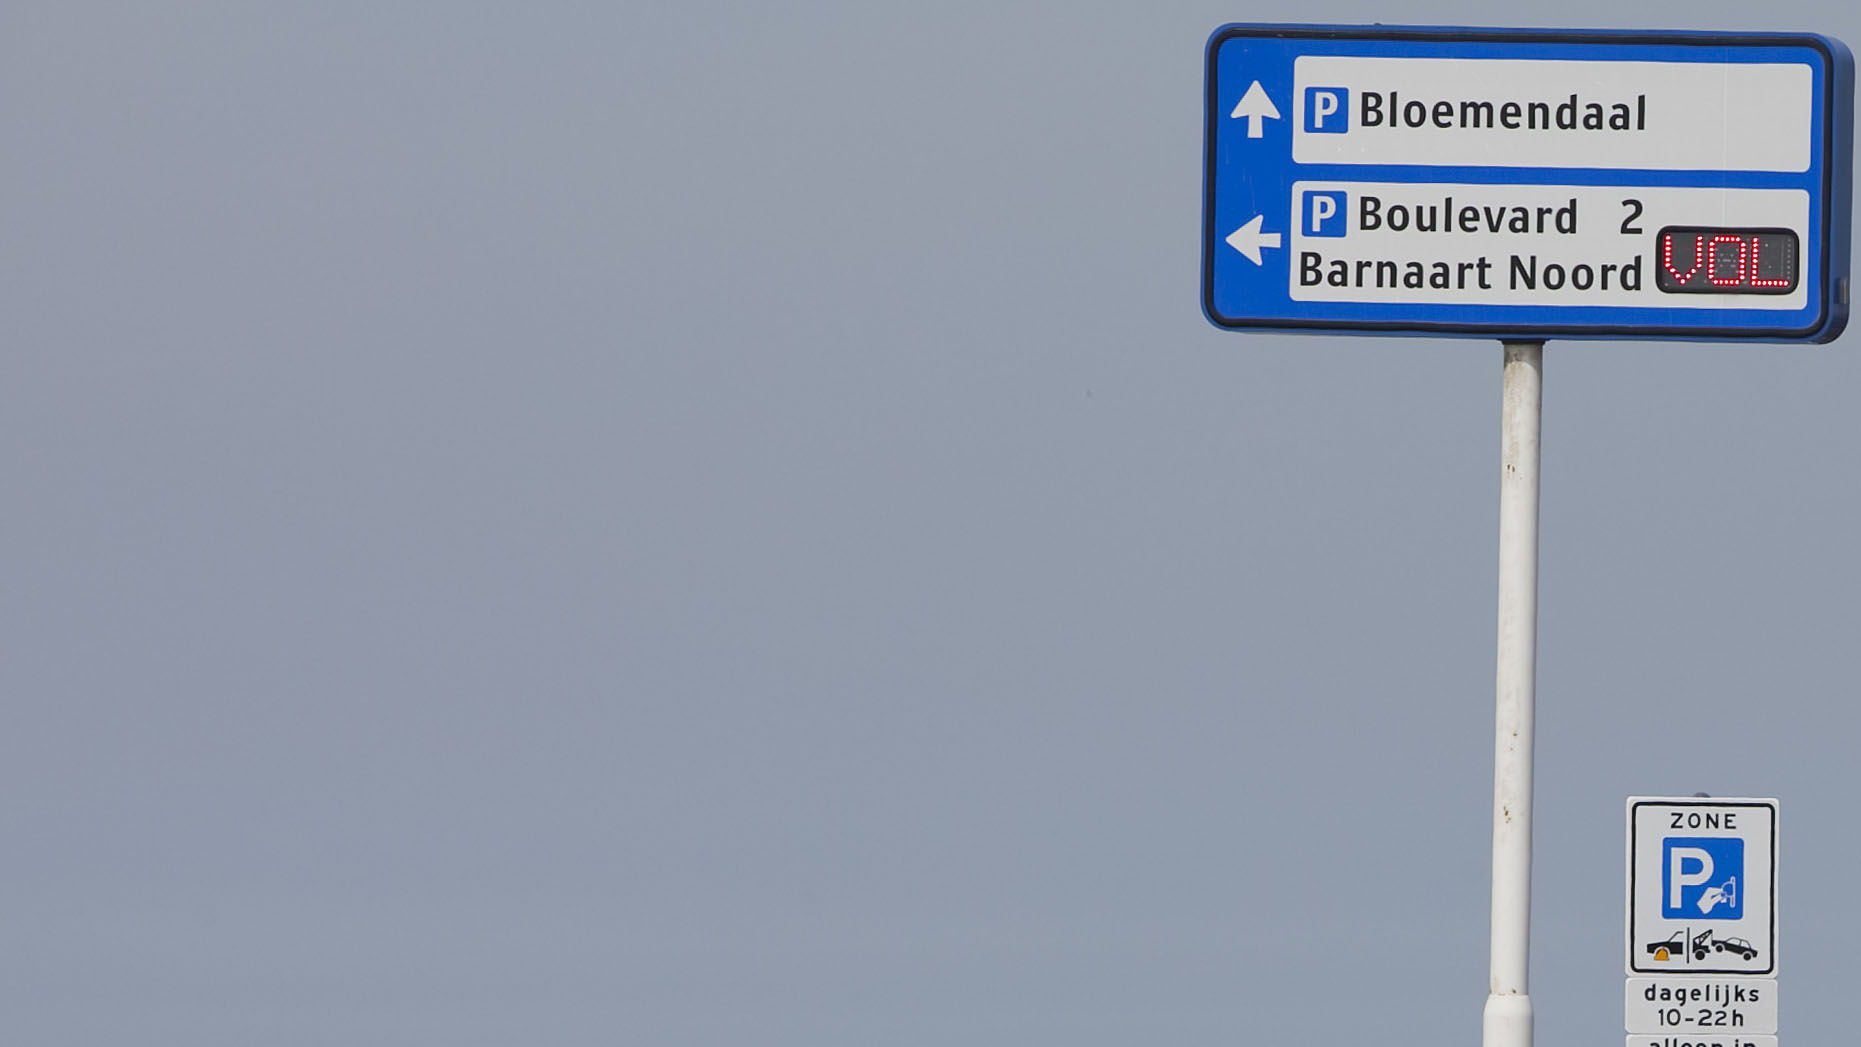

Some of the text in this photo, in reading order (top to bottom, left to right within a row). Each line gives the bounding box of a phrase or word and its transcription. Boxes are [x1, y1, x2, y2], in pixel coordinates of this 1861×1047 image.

[1315, 92, 1646, 131] P Bloemendaal
[1312, 195, 1643, 234] P Boulevard 2
[1300, 252, 1642, 291] Barnaart Noord
[1664, 234, 1788, 286] VOL
[1670, 813, 1737, 829] ZONE
[1670, 847, 1714, 909] P
[1644, 984, 1760, 1007] dagelijks
[1658, 1009, 1744, 1027] 10-22h
